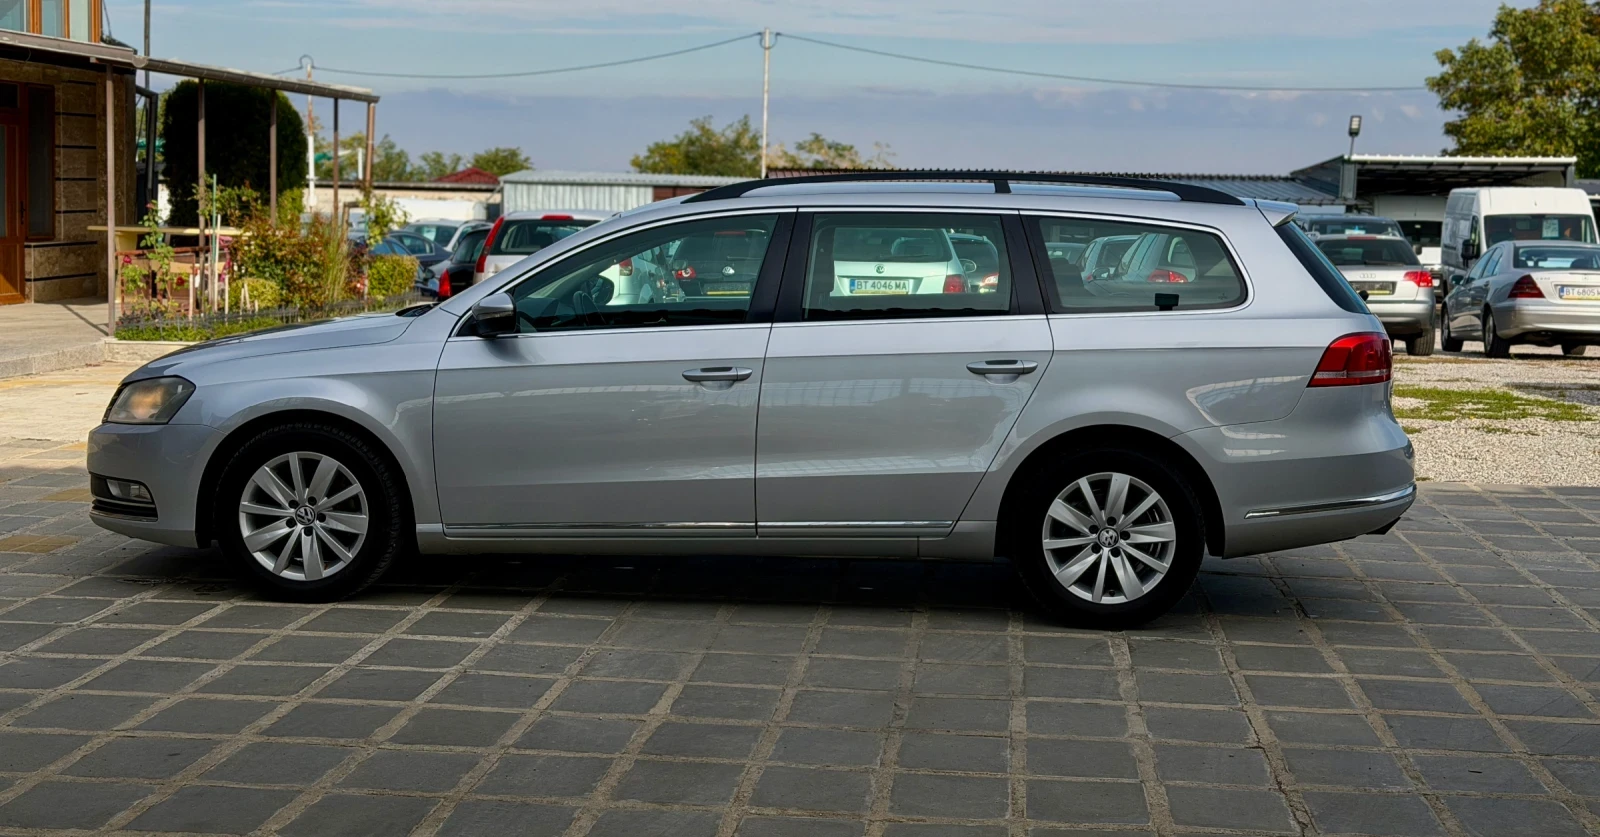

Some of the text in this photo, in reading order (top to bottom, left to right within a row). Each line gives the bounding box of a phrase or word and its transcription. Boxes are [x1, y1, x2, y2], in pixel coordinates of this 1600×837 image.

[856, 281, 907, 290] BT 4046 MA
[296, 506, 315, 525] VW
[1099, 528, 1119, 547] VW
